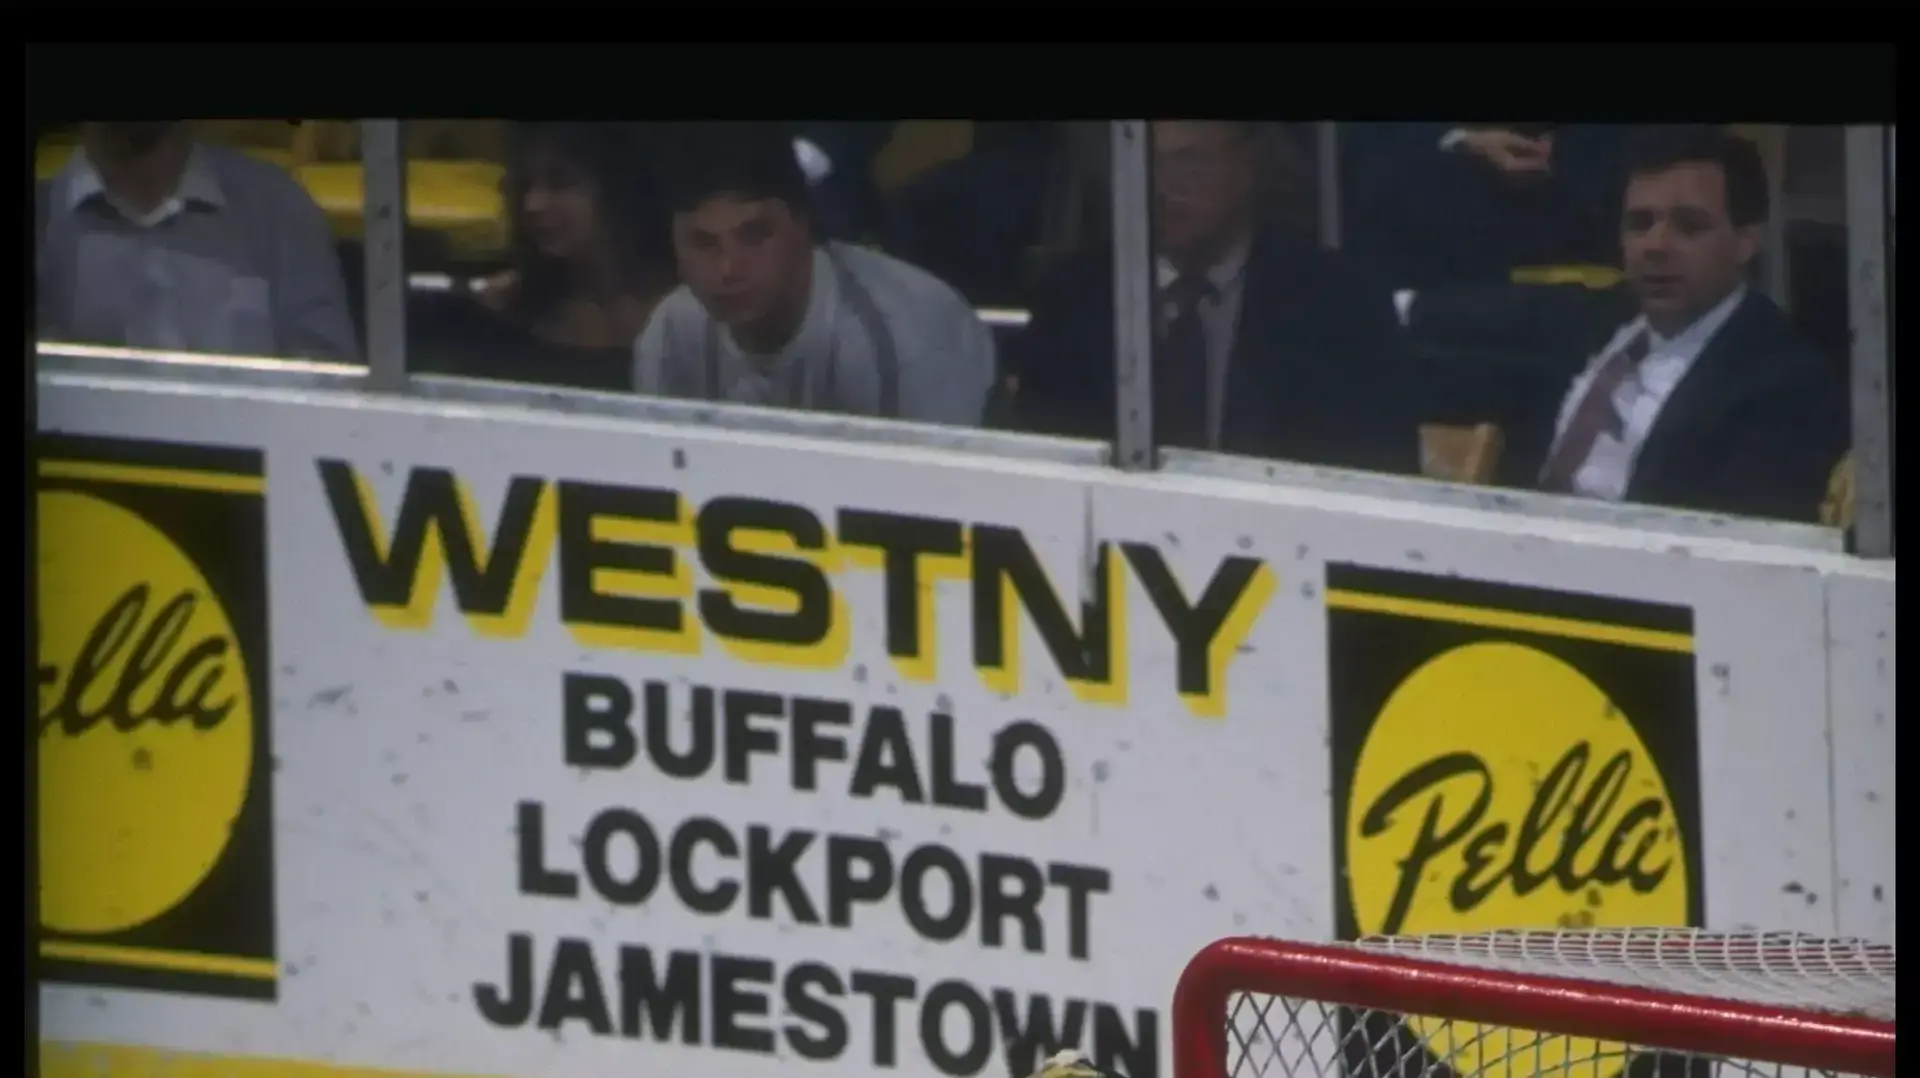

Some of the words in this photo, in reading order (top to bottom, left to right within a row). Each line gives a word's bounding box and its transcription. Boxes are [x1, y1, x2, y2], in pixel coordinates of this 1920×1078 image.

[38, 581, 238, 737] lla
[316, 458, 1277, 717] WESTNY
[563, 672, 1065, 820] BUFFALO
[516, 801, 1110, 960] LOCKPORT
[1359, 741, 1673, 935] Pella
[473, 933, 1158, 1078] JAMESTOWN
